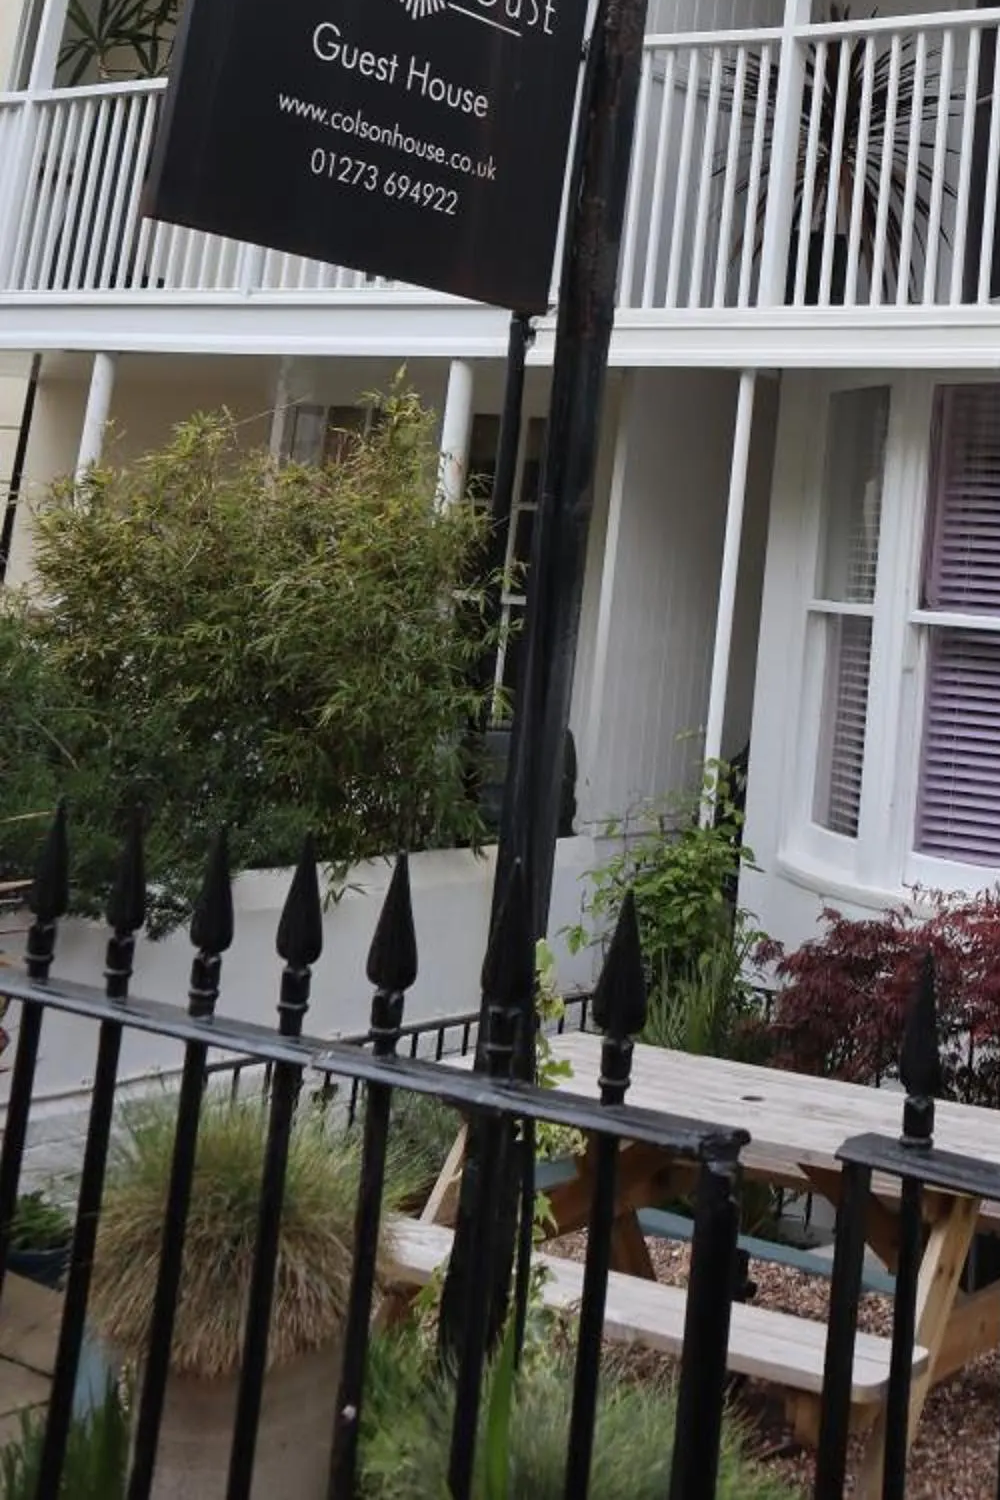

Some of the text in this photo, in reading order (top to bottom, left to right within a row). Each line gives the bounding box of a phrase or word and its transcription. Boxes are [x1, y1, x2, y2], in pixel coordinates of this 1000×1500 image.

[312, 22, 489, 117] Guest House
[278, 92, 497, 180] www.colsonhouse.co.uk
[310, 147, 458, 215] 01273 694922
